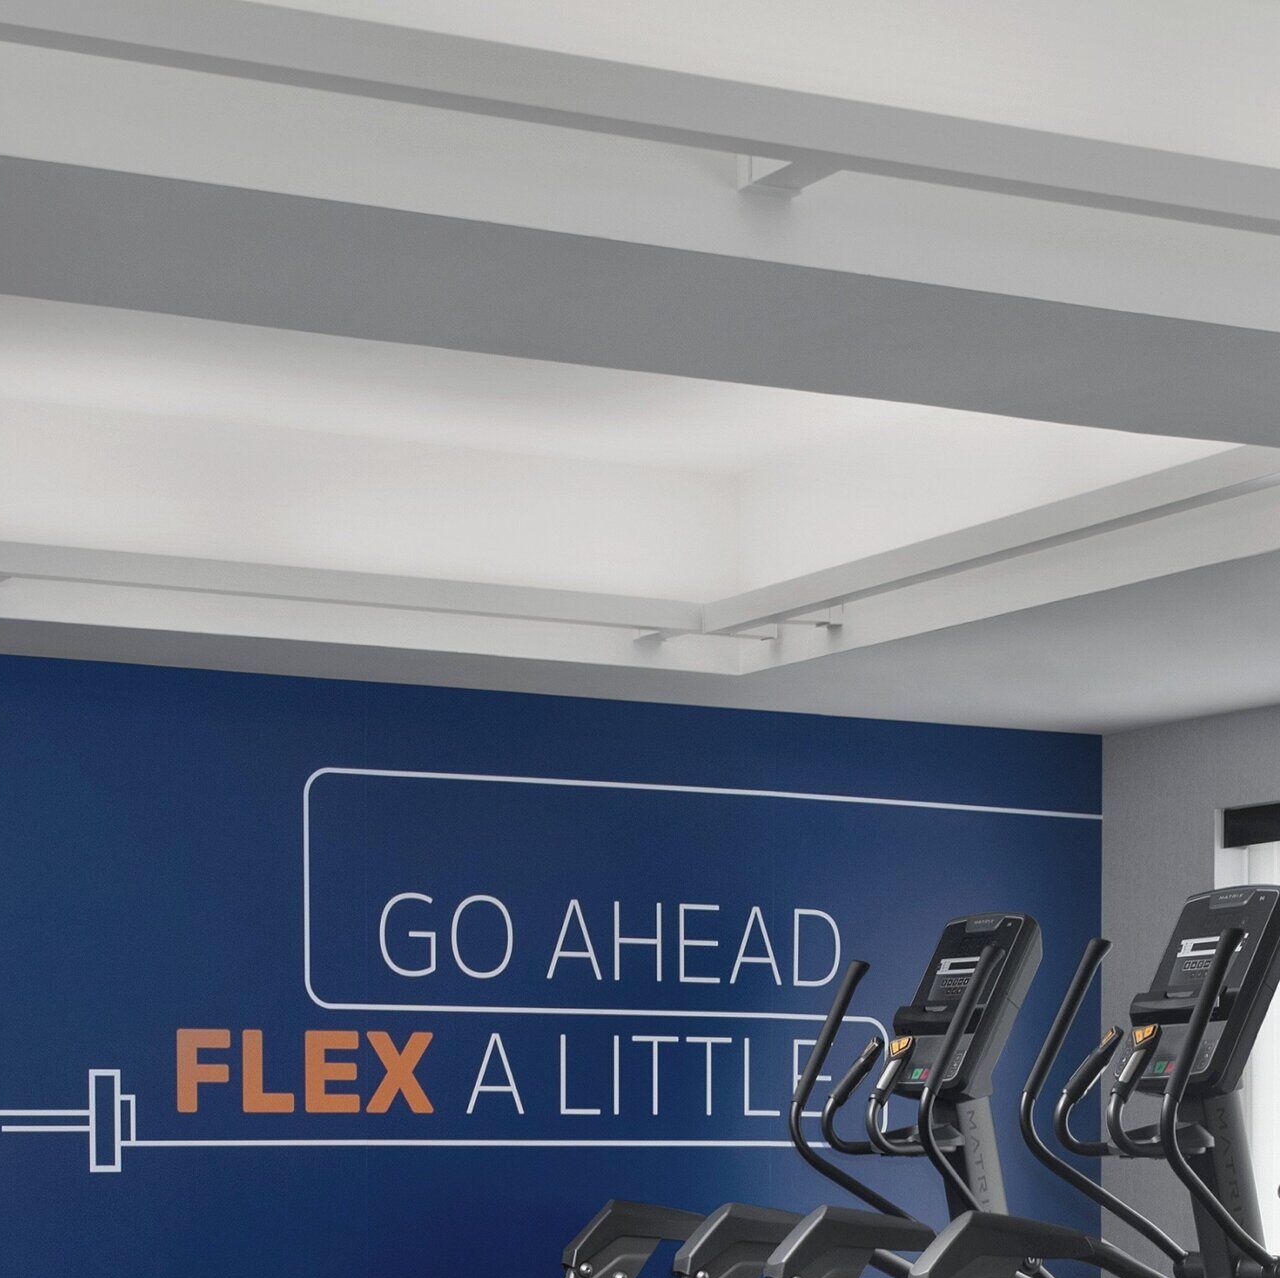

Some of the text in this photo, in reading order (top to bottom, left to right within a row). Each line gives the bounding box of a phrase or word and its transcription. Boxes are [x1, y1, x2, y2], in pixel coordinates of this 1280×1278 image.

[379, 892, 842, 988] GO AHEAD
[175, 1027, 833, 1118] FLEX A LITTLE
[966, 1109, 992, 1214] MATRI
